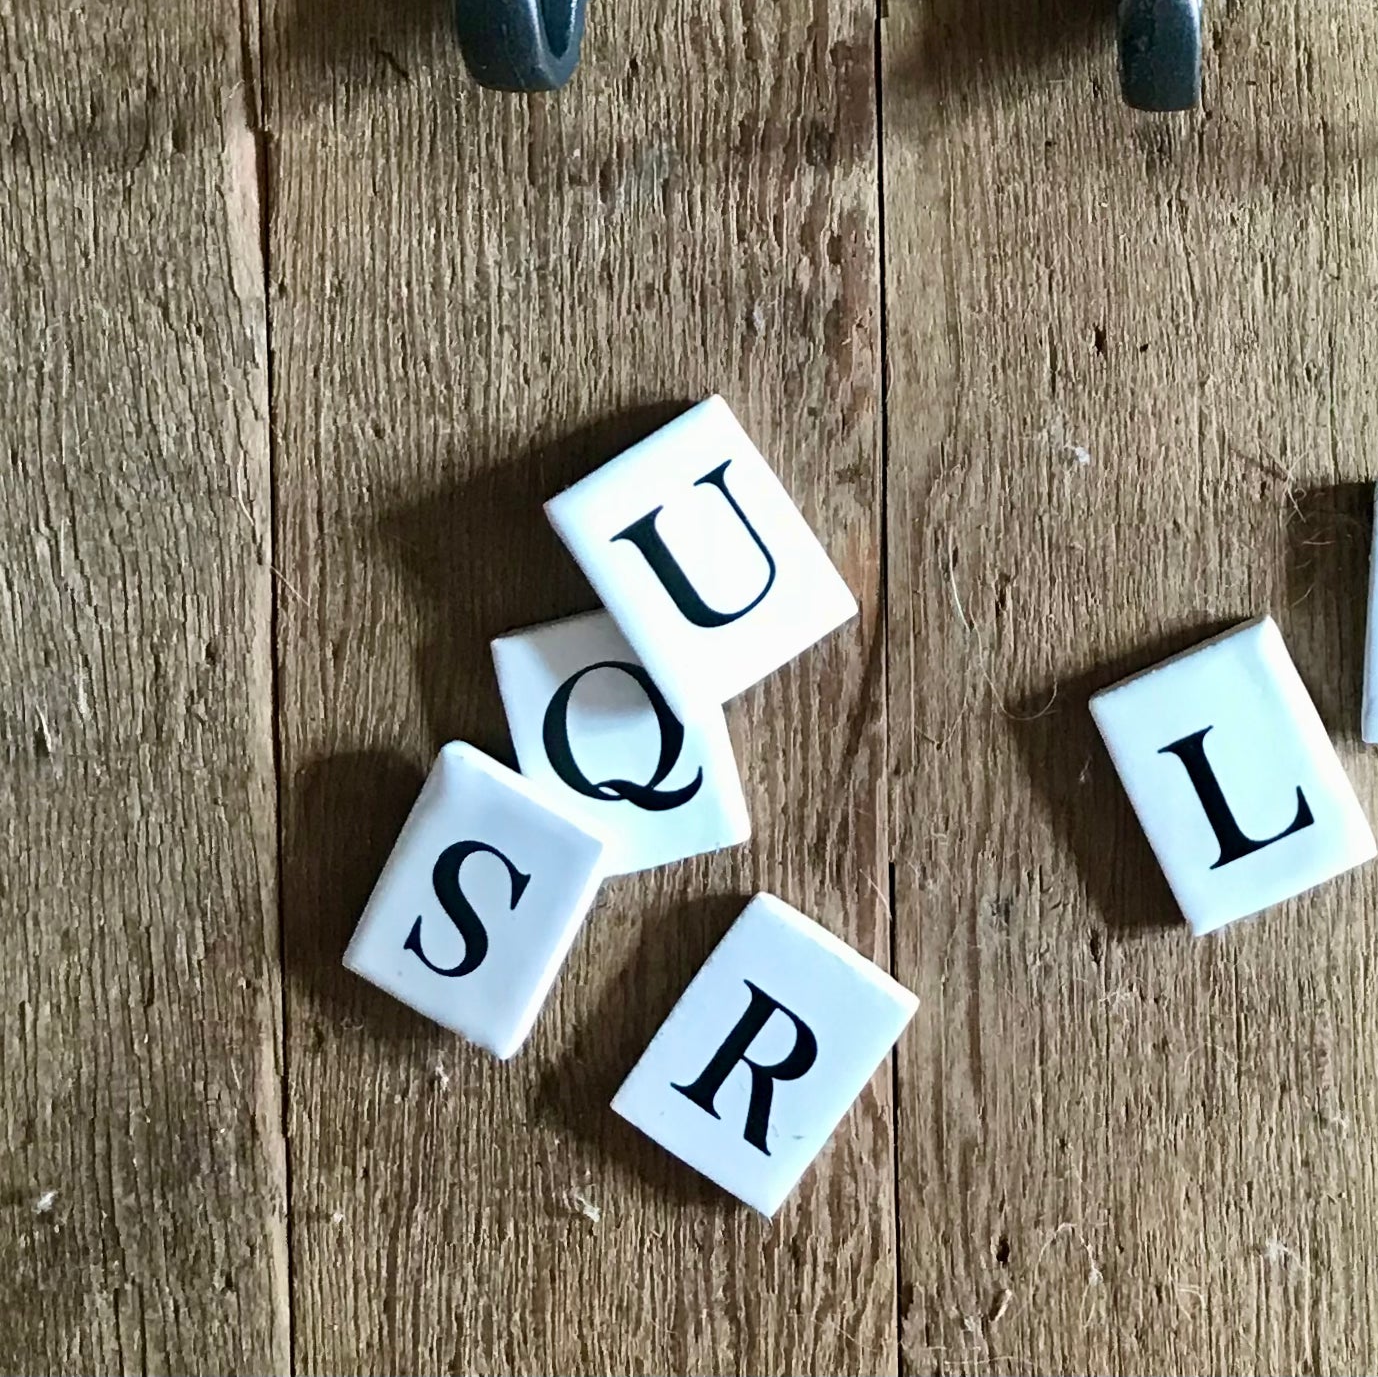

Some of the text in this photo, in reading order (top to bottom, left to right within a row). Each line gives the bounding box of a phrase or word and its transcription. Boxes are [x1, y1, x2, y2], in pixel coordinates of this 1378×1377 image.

[608, 458, 777, 629] U
[541, 658, 704, 813] Q
[403, 840, 532, 978] S
[670, 979, 819, 1157] R
